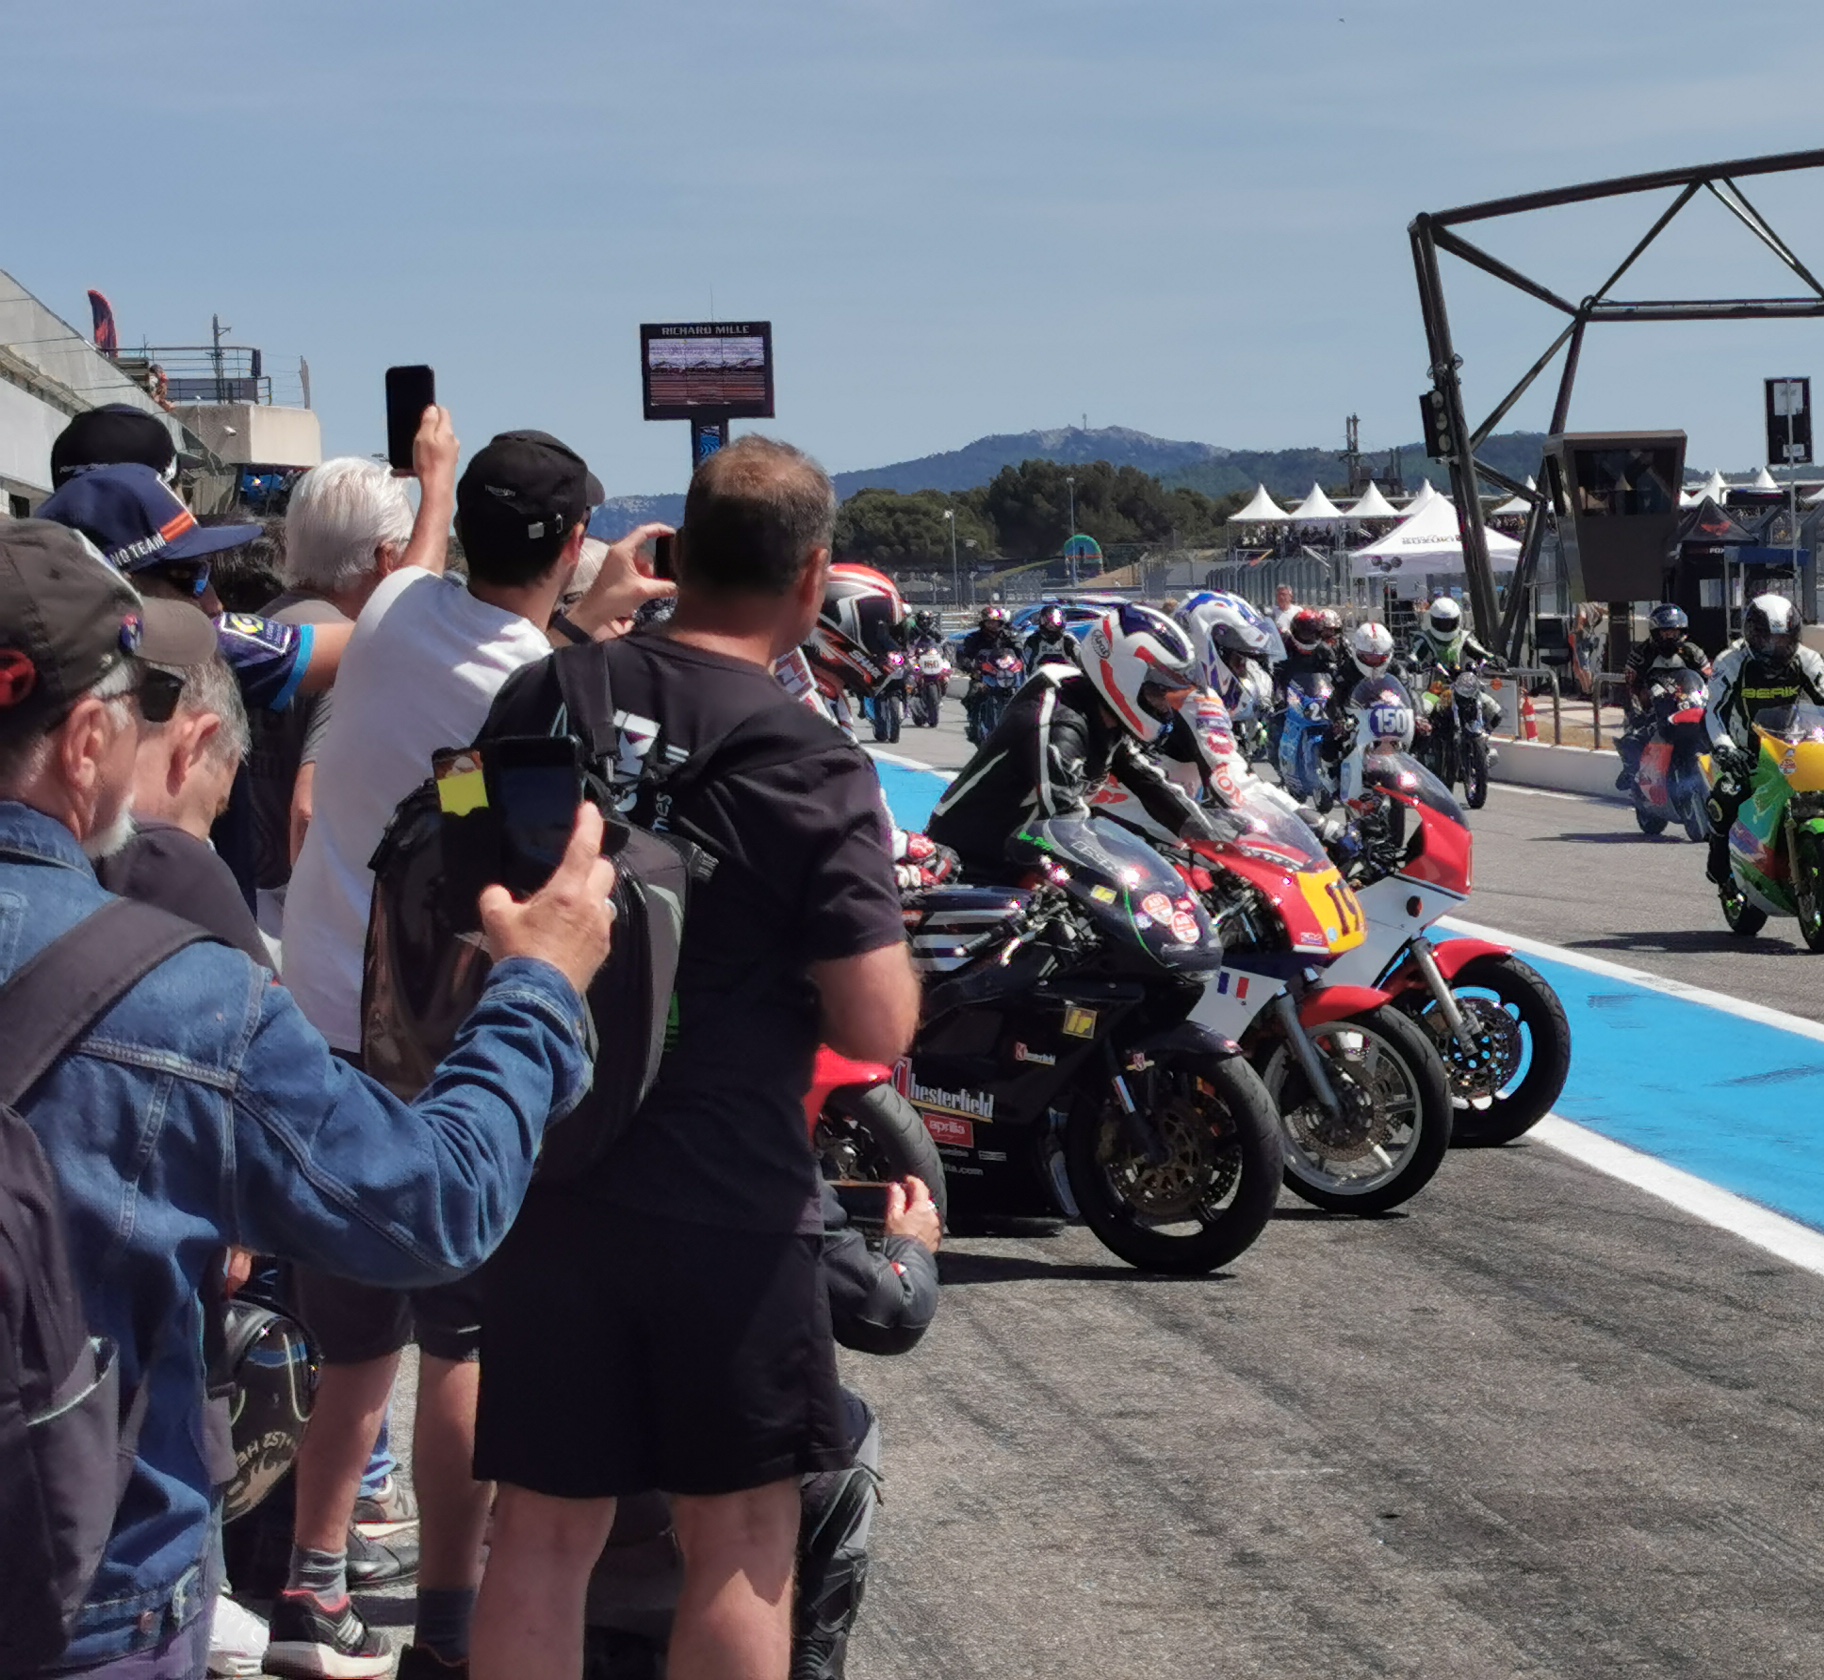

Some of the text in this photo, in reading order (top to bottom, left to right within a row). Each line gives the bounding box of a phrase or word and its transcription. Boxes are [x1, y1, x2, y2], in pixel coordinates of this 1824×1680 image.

[661, 325, 750, 336] RICHARD MILLE
[129, 532, 168, 561] TEAM
[849, 649, 885, 680] SHARK
[1375, 708, 1408, 733] 150
[891, 1056, 995, 1119] Chesterfield
[929, 1120, 966, 1135] aprilia
